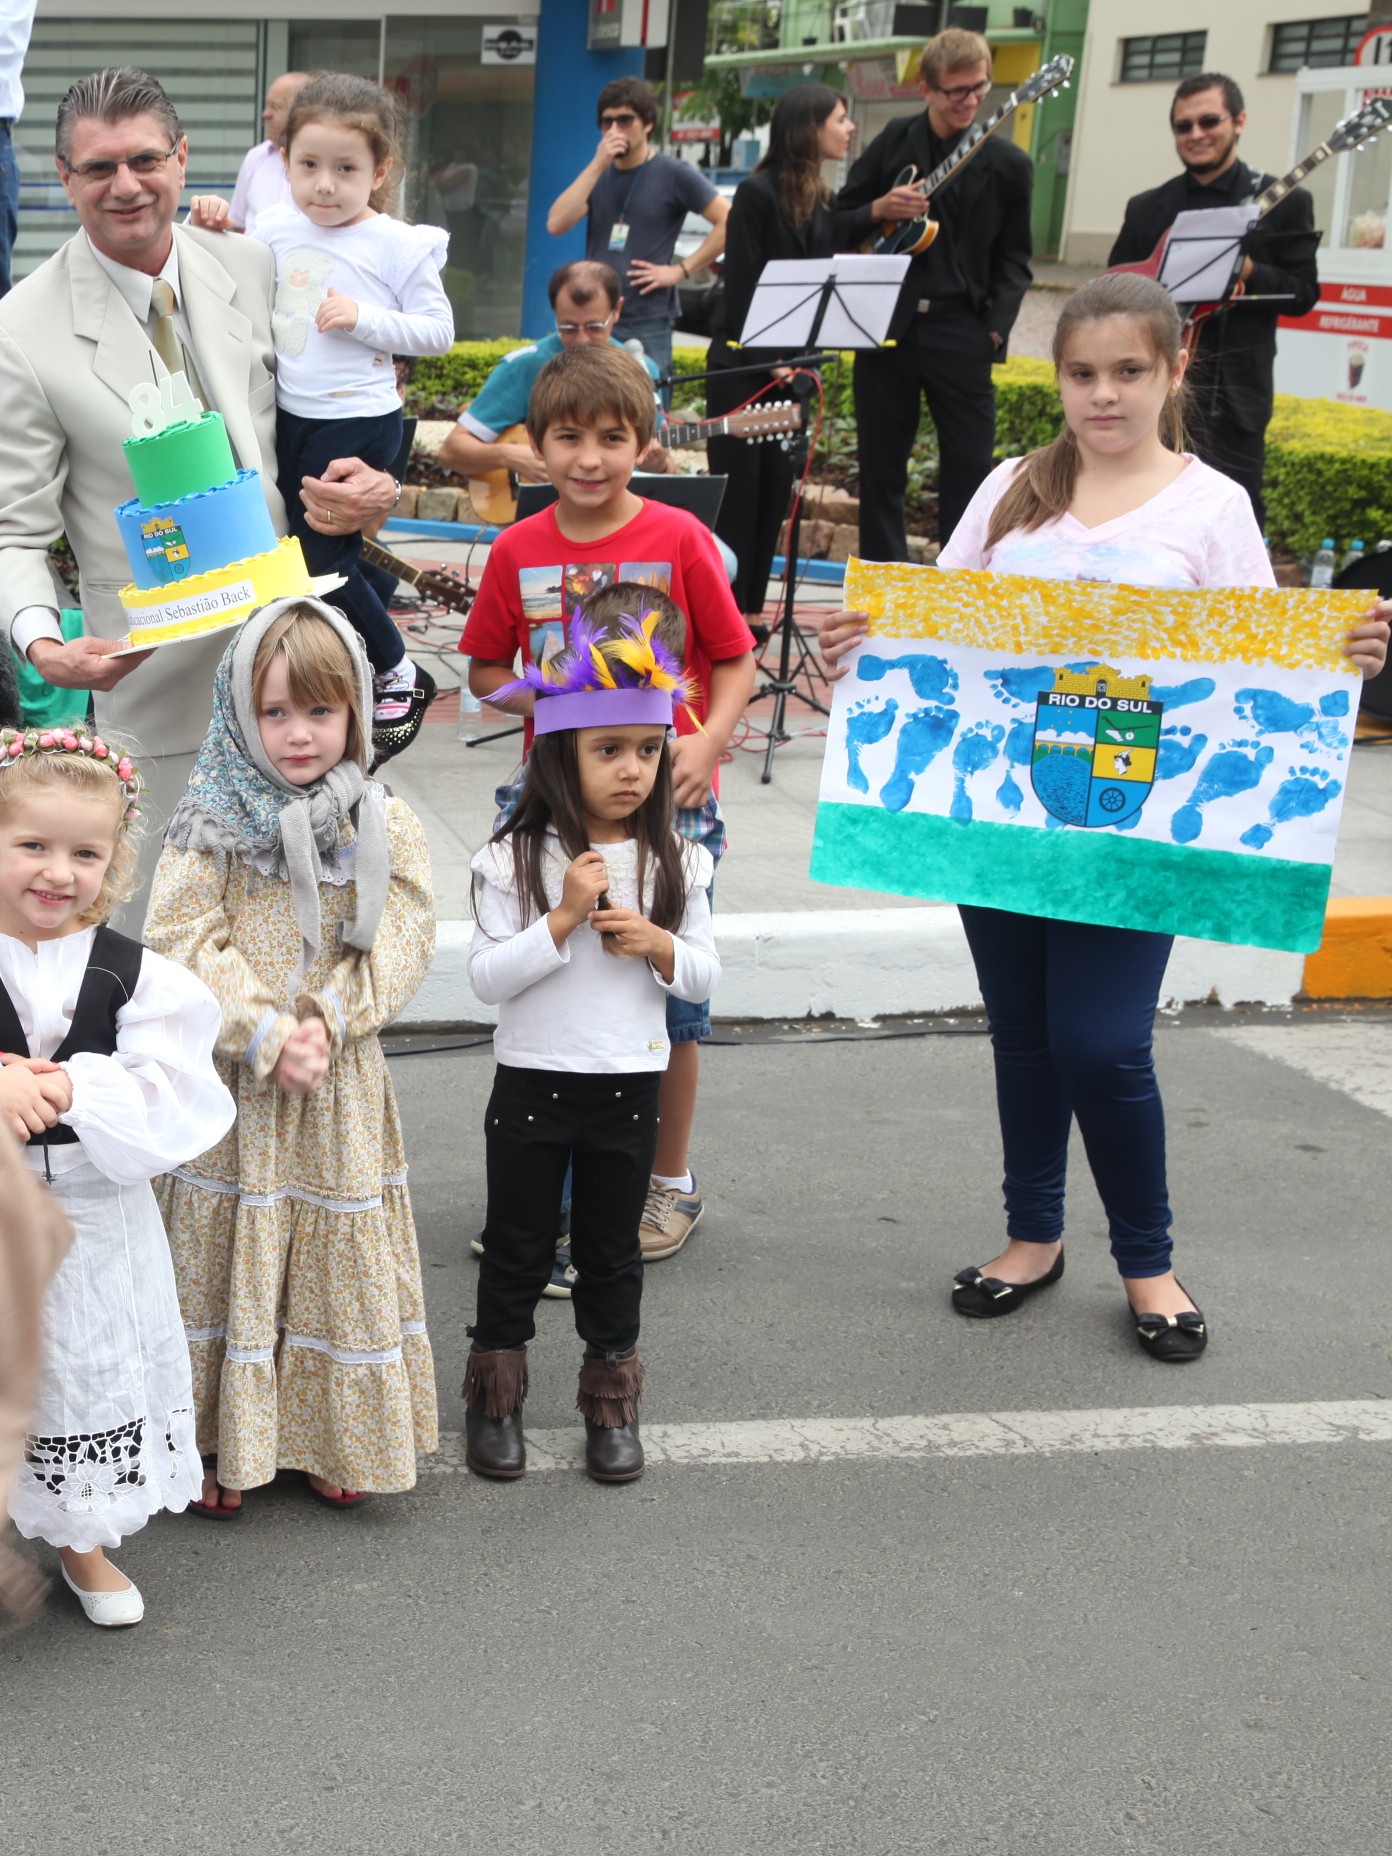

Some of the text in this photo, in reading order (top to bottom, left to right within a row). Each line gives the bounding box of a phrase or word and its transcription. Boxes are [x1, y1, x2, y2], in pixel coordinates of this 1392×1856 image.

[1340, 286, 1367, 302] ÁGUA
[128, 370, 205, 439] 84
[164, 598, 219, 621] Sebastião
[220, 586, 251, 606] Back
[1048, 693, 1152, 714] RIO DO SUL
